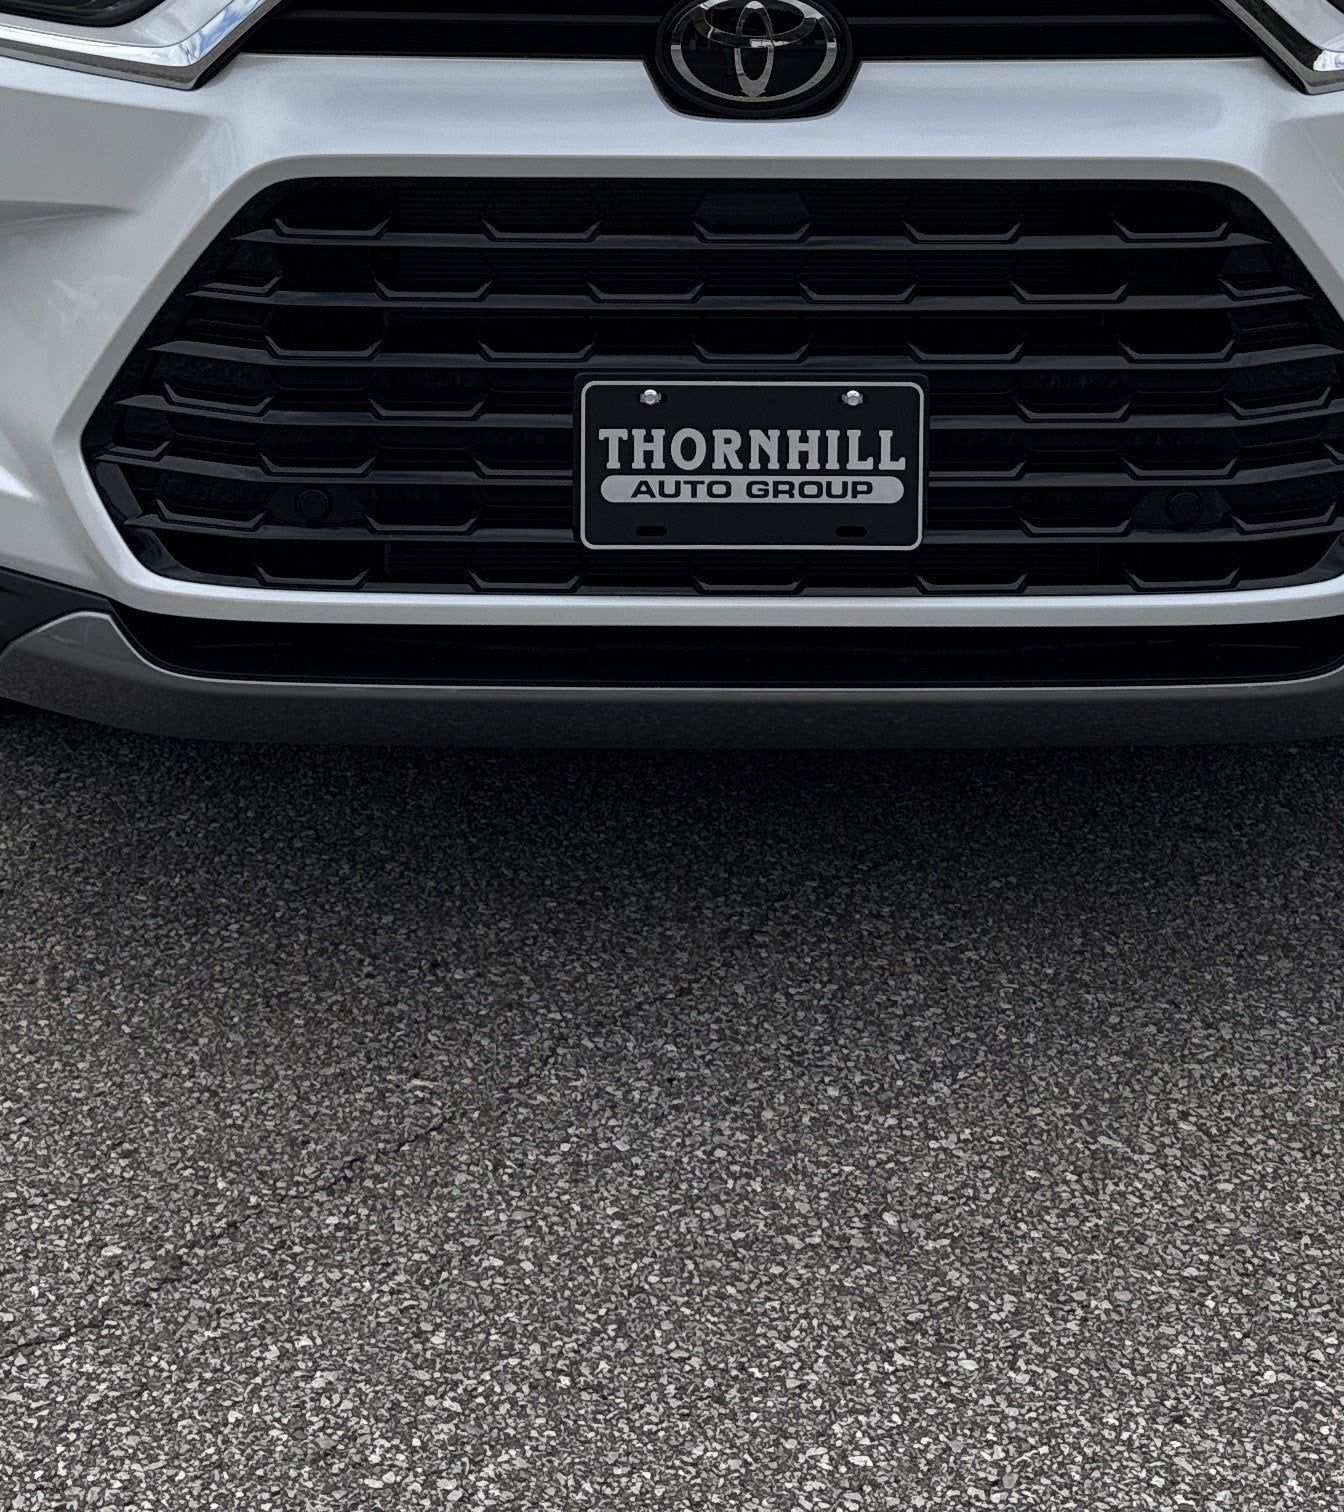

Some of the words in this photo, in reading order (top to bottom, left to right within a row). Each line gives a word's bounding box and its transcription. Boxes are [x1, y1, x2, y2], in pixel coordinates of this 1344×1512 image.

[598, 427, 906, 471] THORNHILL
[630, 480, 733, 499] AUTO
[745, 480, 874, 499] GROUP
